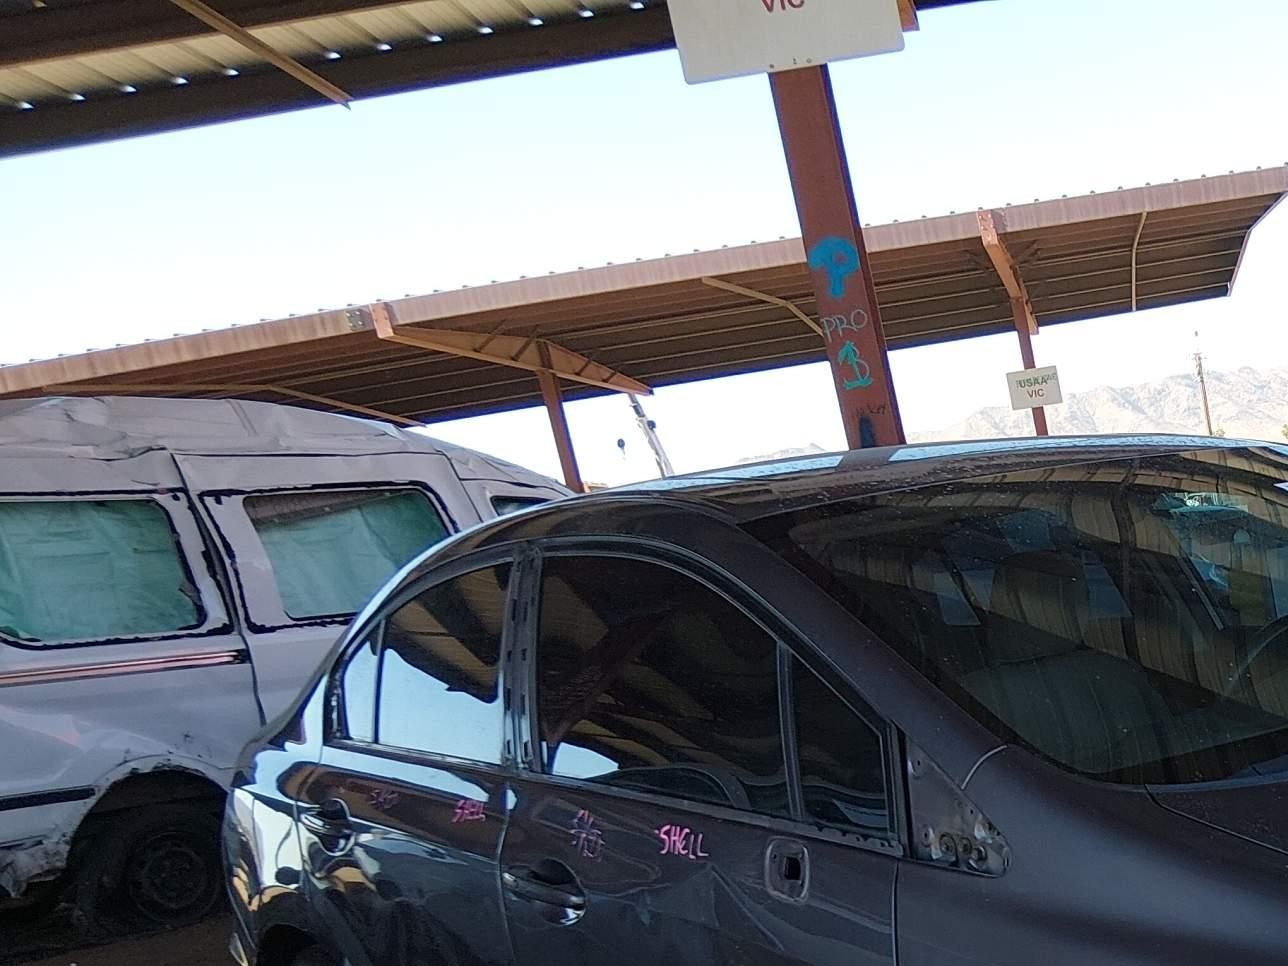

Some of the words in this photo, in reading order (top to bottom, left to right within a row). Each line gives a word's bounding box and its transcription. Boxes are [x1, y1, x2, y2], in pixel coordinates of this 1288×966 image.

[820, 308, 868, 343] PRO
[1026, 388, 1045, 398] VIC
[658, 824, 710, 860] SHELL
